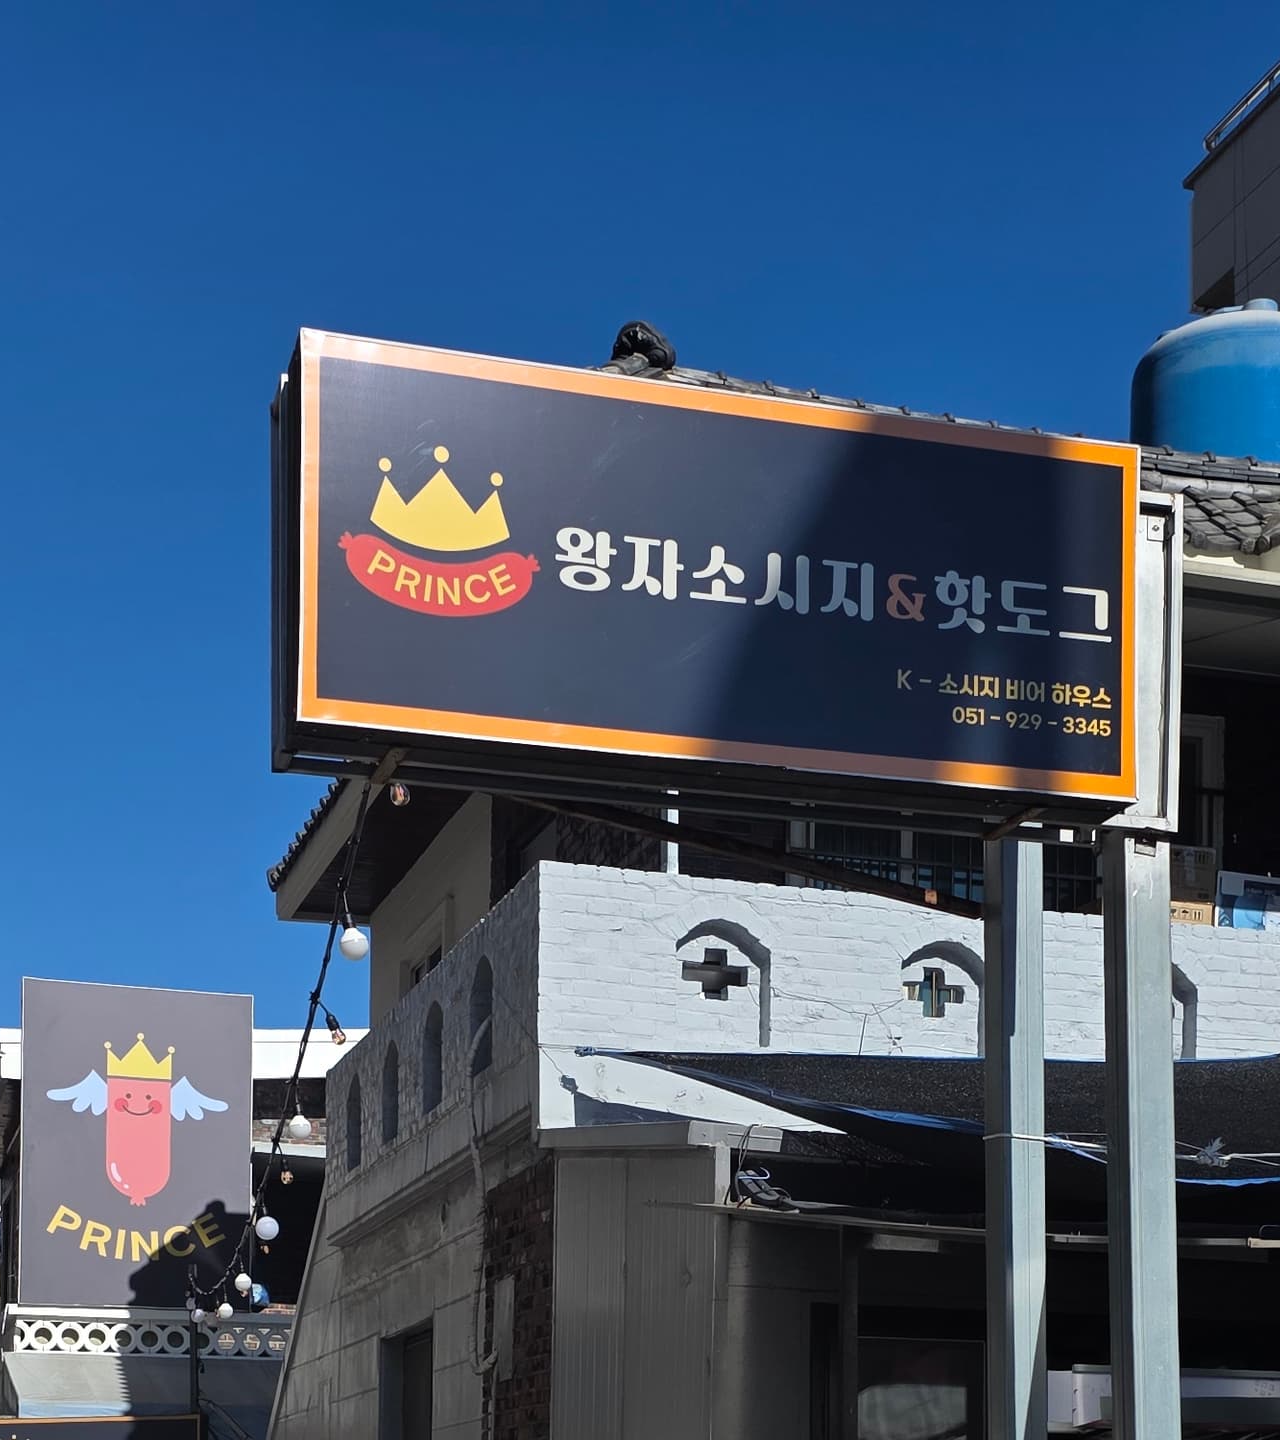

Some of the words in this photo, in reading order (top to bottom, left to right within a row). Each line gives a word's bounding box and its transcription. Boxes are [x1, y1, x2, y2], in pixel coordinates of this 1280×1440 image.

[367, 548, 517, 606] PRINCE
[554, 526, 1113, 643] 왕자소시지&핫도그
[939, 673, 1000, 699] 소시지
[1005, 678, 1045, 703] 비어
[1051, 682, 1112, 710] 하우스
[46, 1204, 226, 1262] PRINCE
